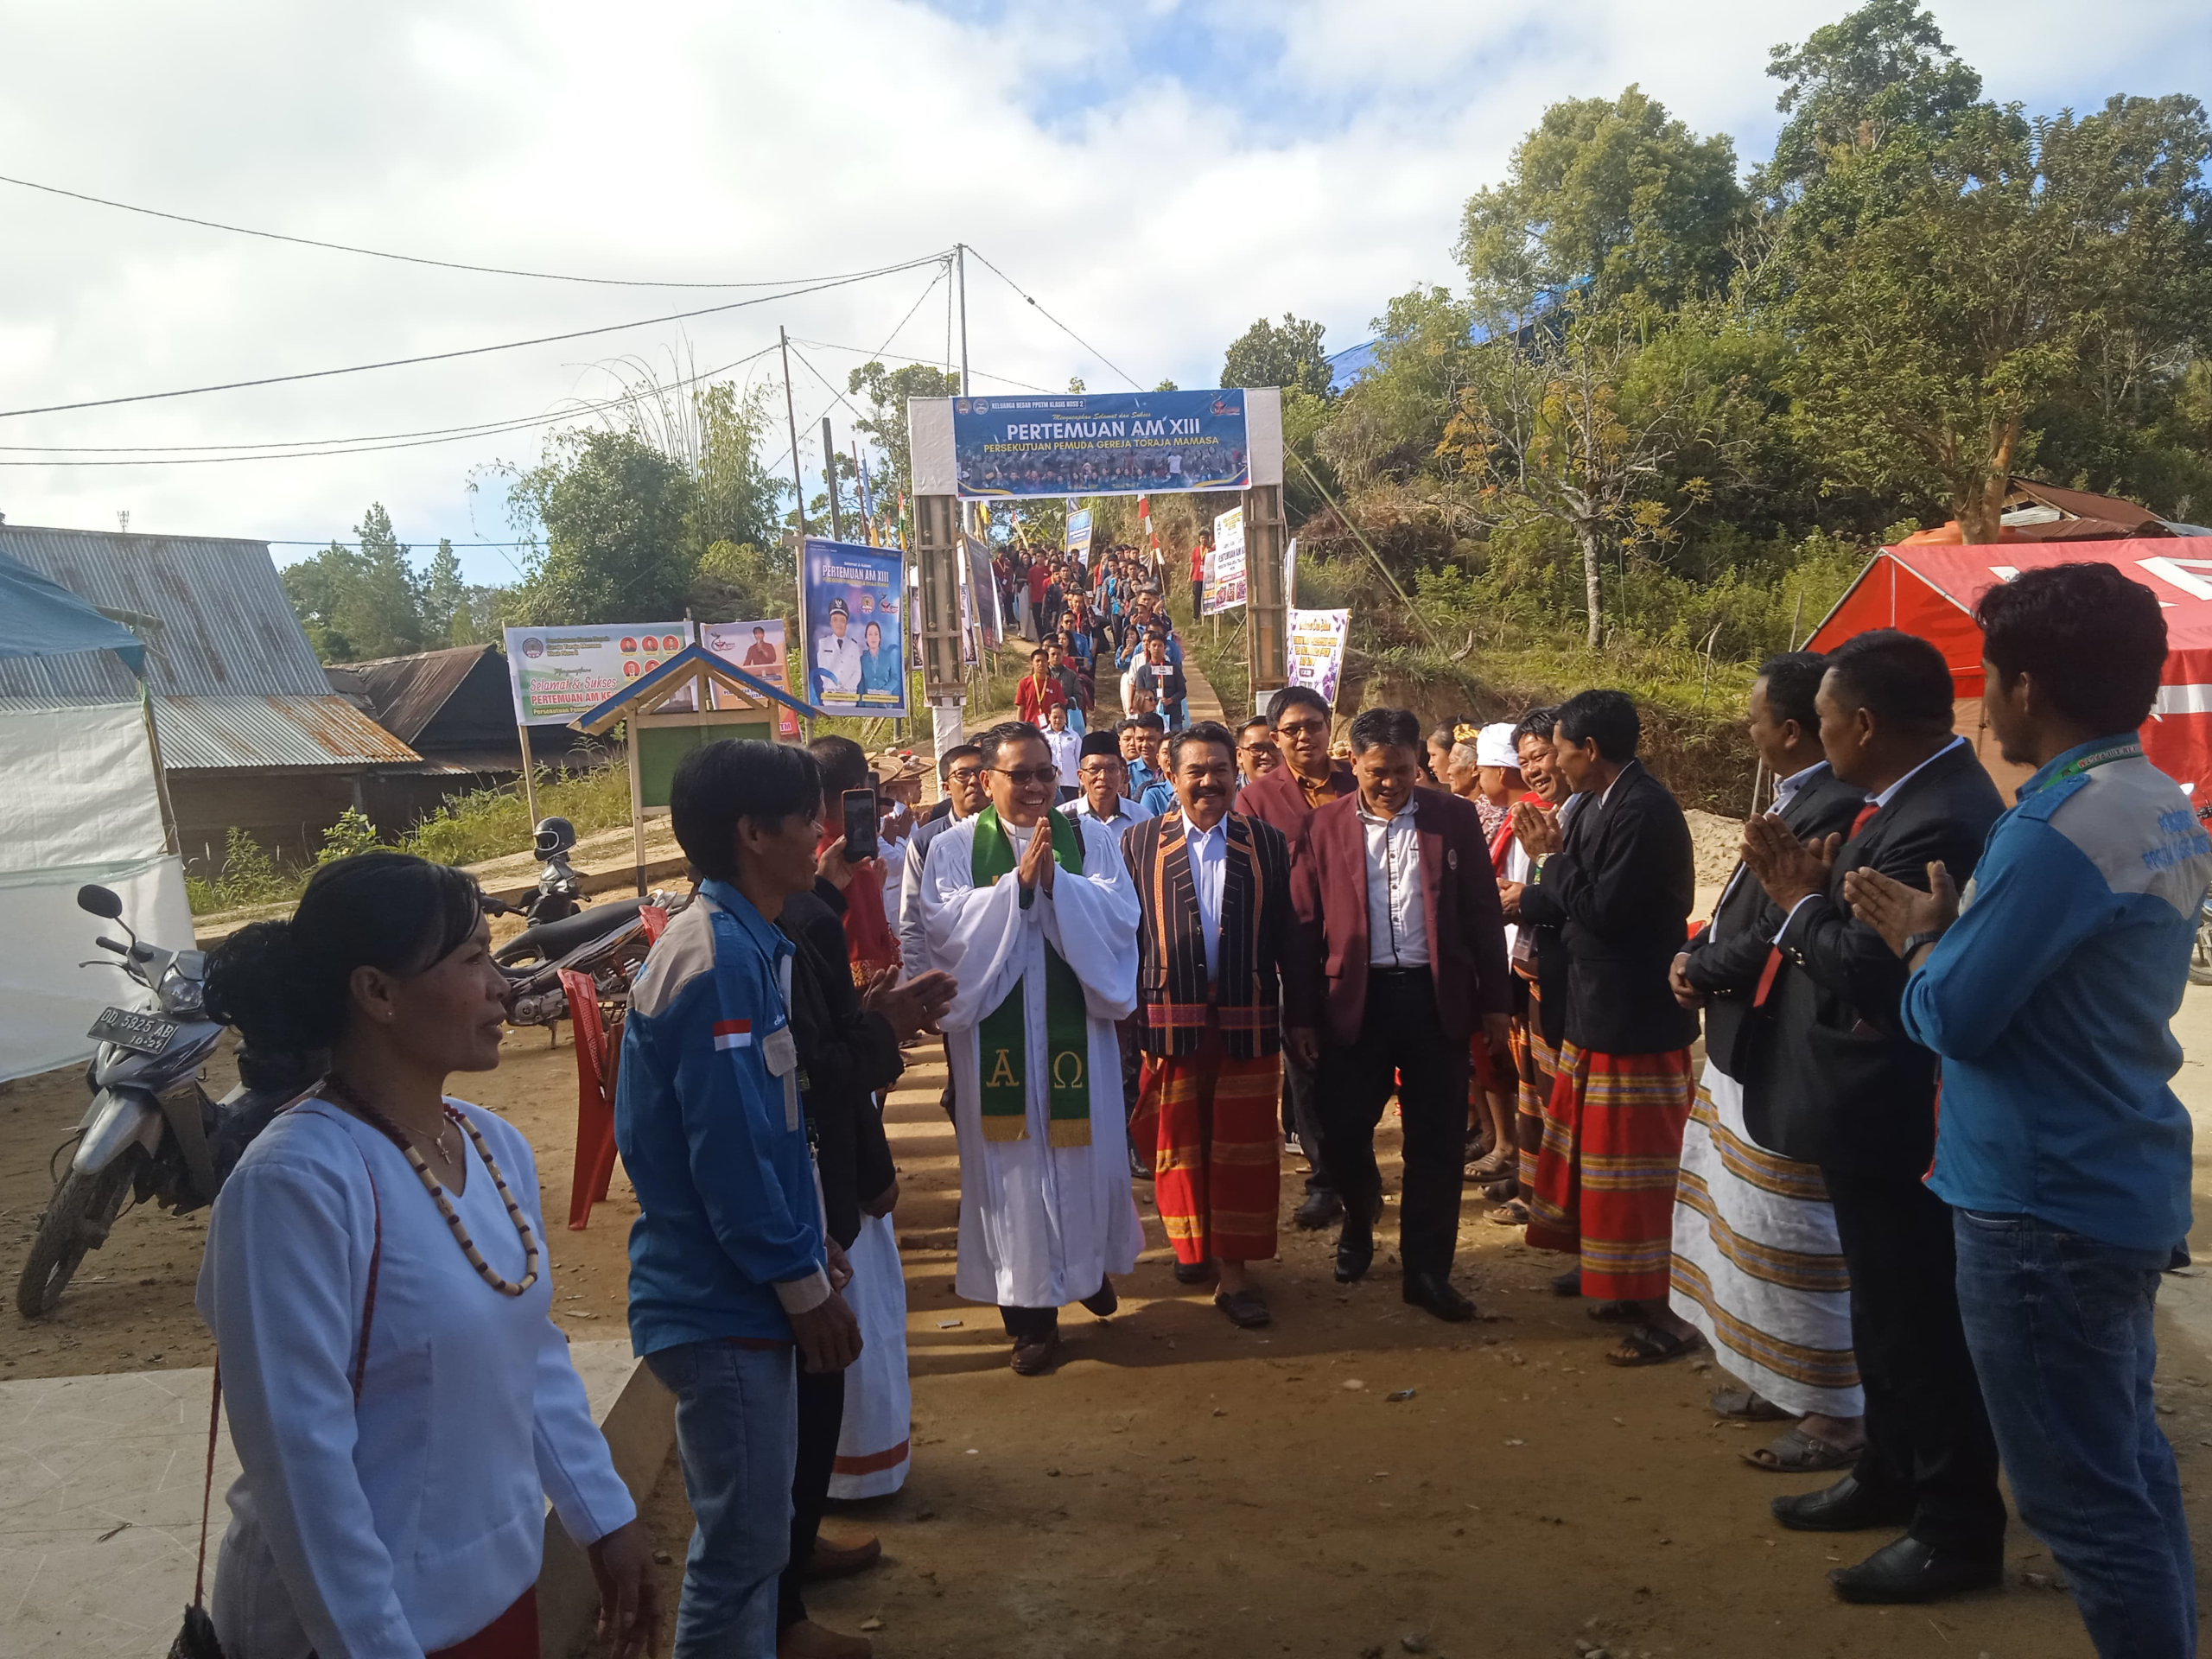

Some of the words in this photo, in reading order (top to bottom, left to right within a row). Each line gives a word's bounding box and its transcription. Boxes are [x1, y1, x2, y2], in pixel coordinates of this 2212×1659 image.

[1007, 420, 1125, 441] PERTEMUAN
[1131, 419, 1165, 436] AM
[1169, 418, 1200, 435] XIII
[983, 442, 1052, 453] PERSEKUTUAN
[1054, 442, 1094, 450] PEMUDA
[1096, 439, 1132, 448] GEREJA
[1134, 438, 1172, 448] TORAJA
[1173, 436, 1219, 446] MAMASA
[823, 565, 864, 581] PERTEMUAN
[865, 569, 877, 582] AM
[877, 570, 889, 582] XIII
[531, 678, 569, 691] Selamat
[572, 677, 582, 690] &
[584, 676, 617, 690] Sukses
[531, 693, 583, 705] PERTEMUAN
[586, 692, 599, 702] AM
[100, 1009, 119, 1025] DD
[154, 1024, 174, 1038] AB
[986, 1049, 1020, 1087] A
[1053, 1051, 1083, 1088] Ω
